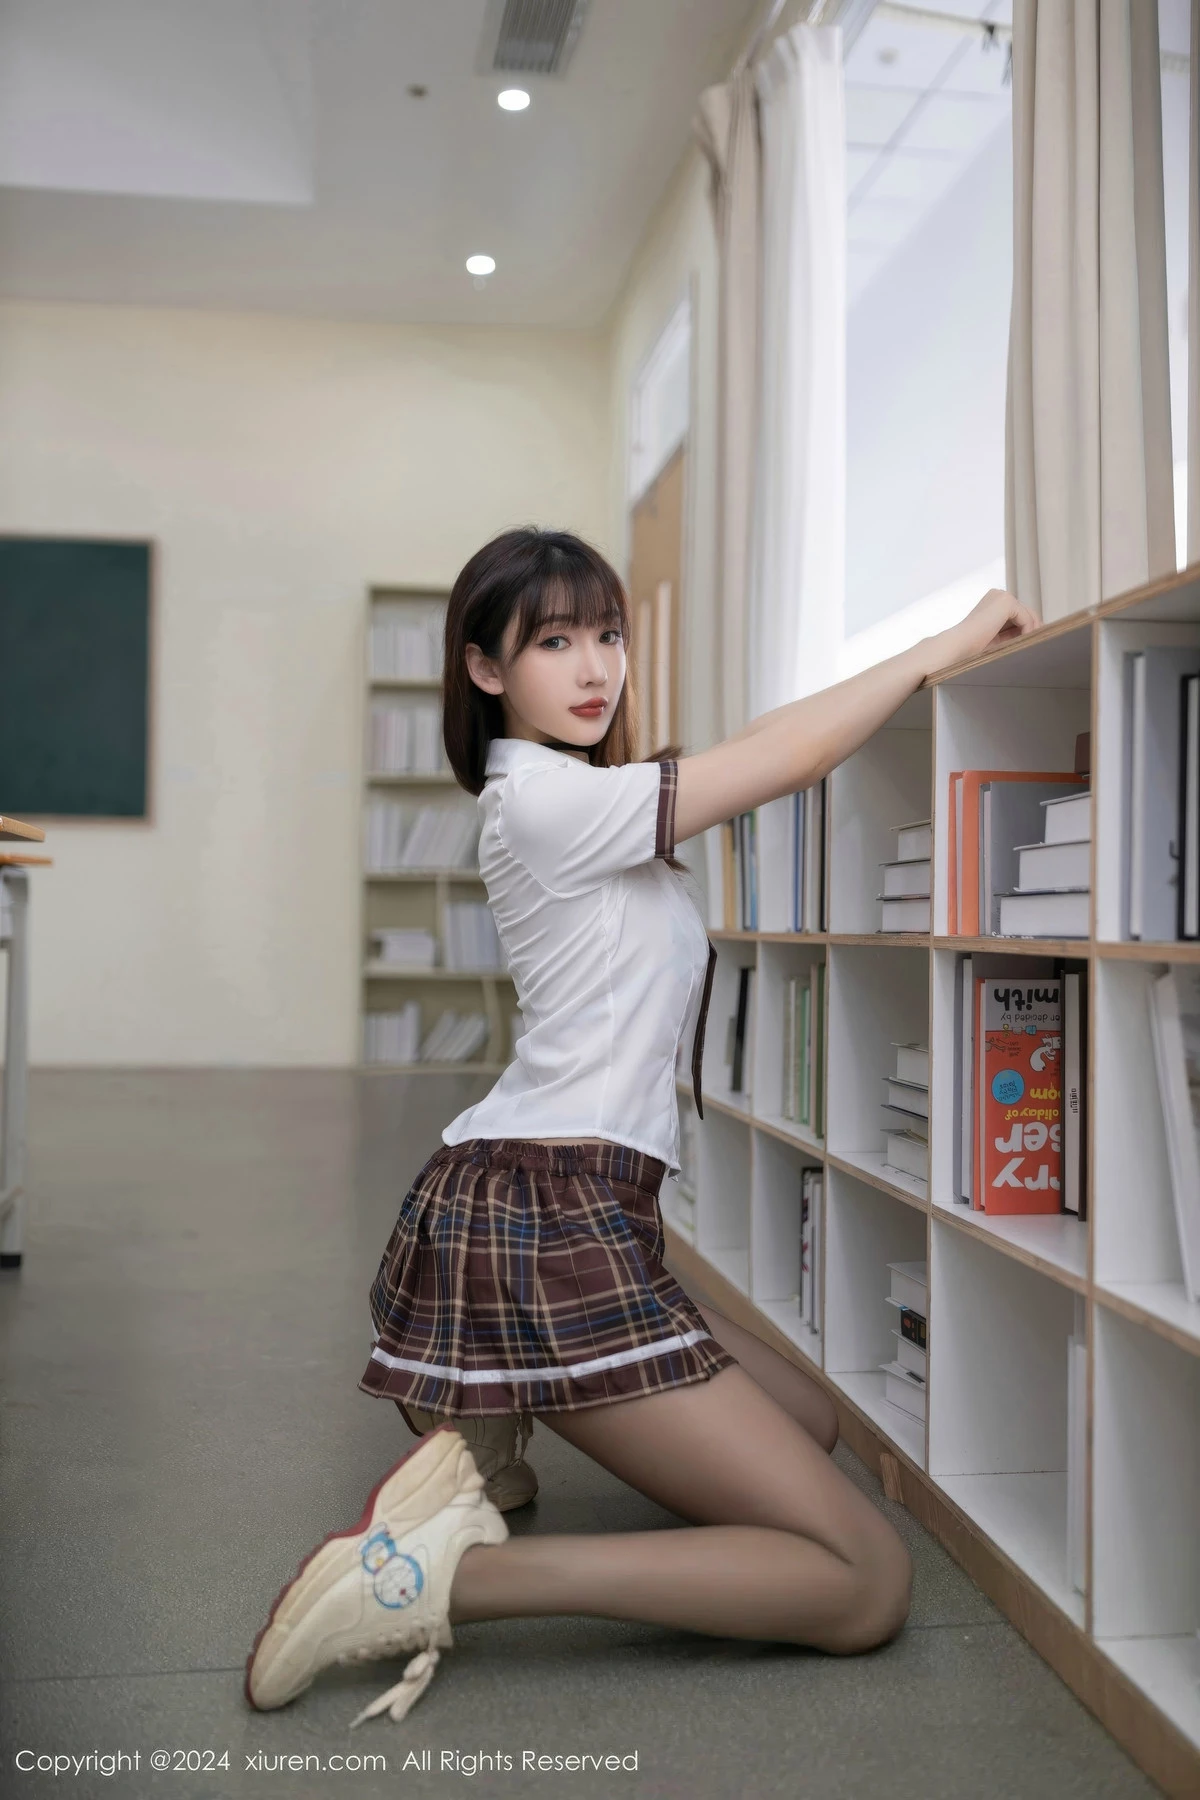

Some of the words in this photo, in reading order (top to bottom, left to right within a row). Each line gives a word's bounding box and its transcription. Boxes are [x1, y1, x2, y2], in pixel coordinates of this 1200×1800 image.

[994, 989, 1059, 1011] mith
[1000, 1013, 1011, 1022] by
[1015, 1014, 1048, 1022] decided
[1029, 1088, 1061, 1100] om
[1004, 1109, 1019, 1120] of
